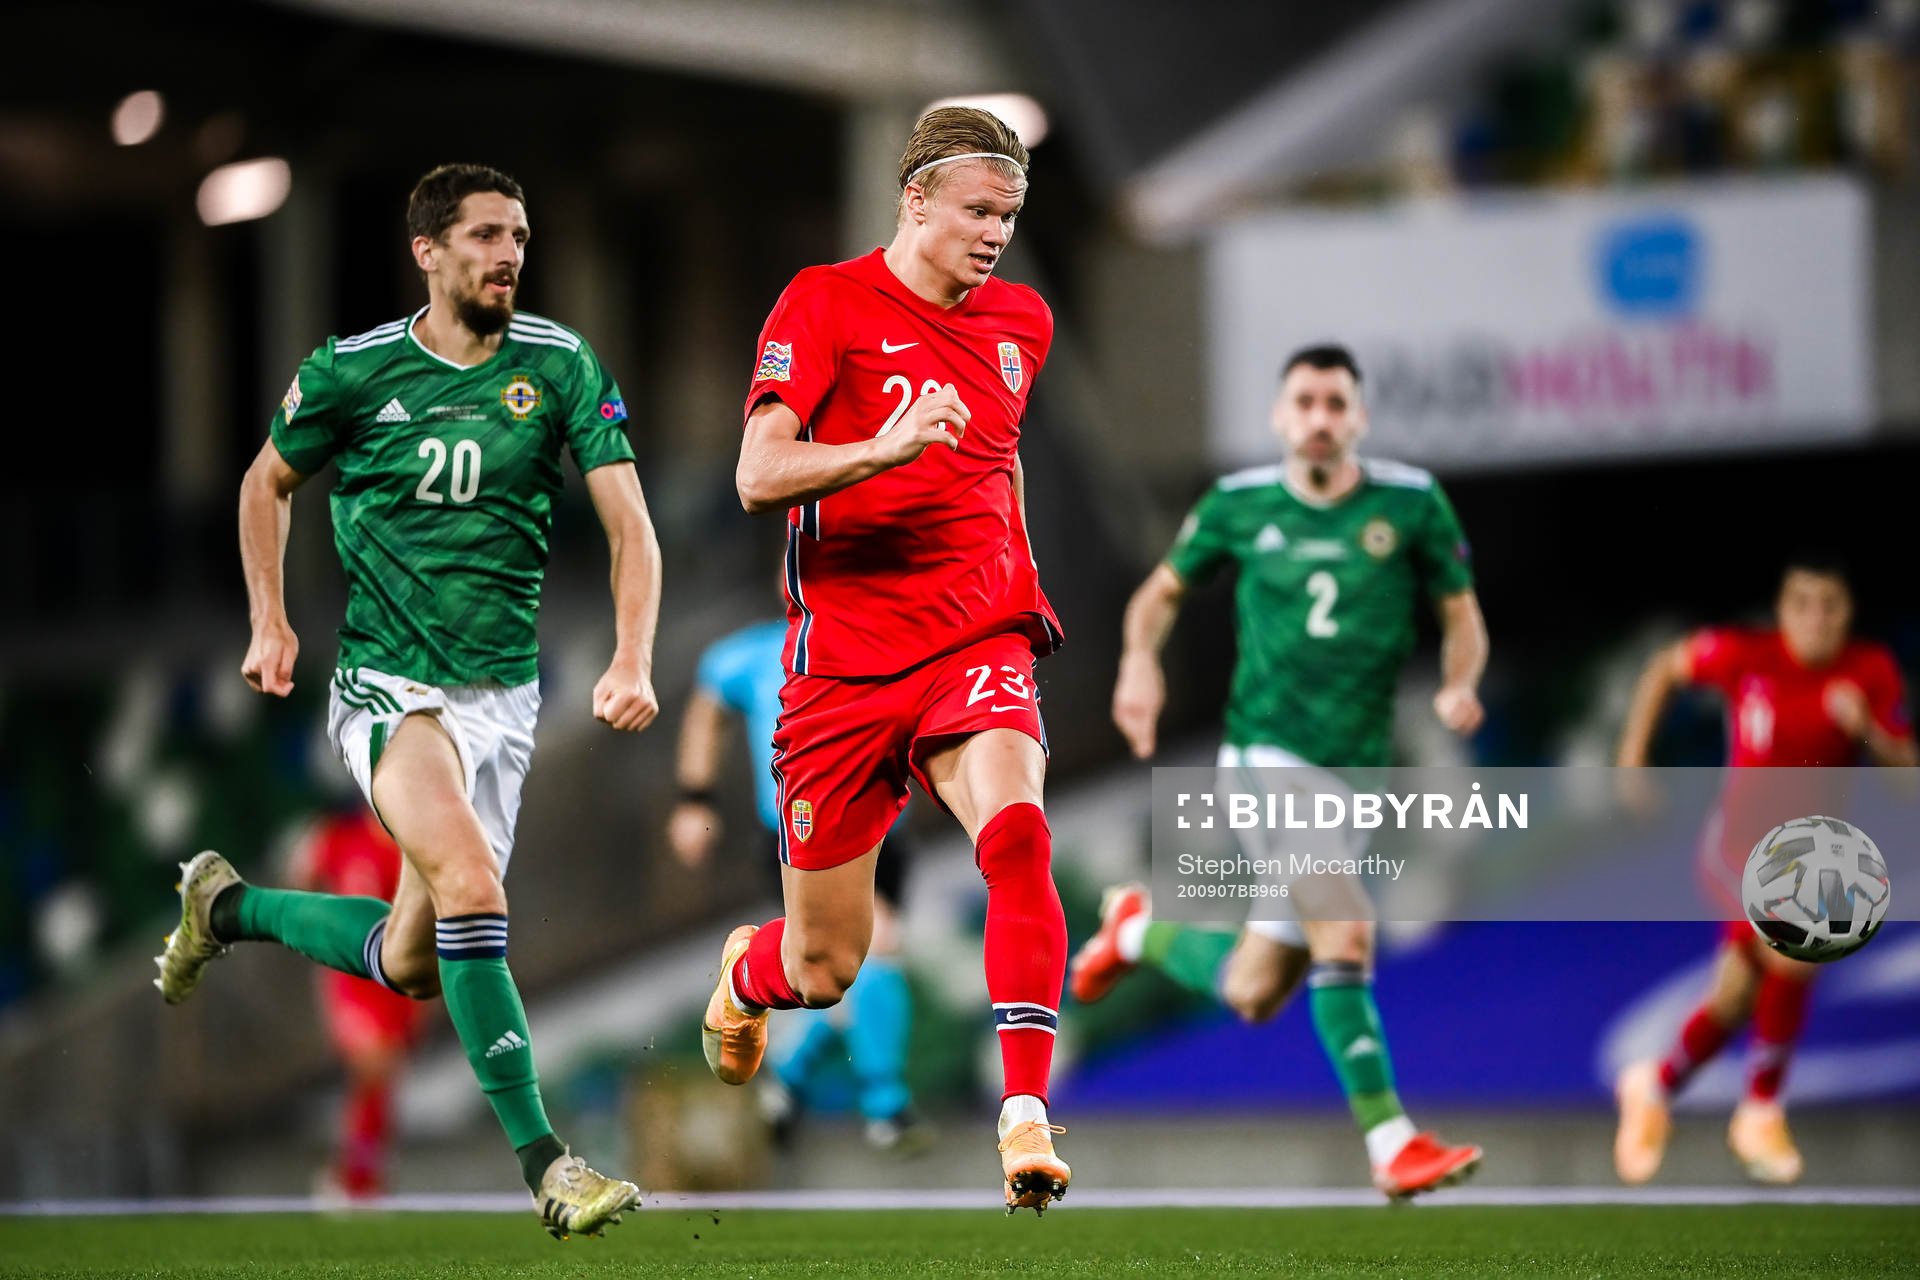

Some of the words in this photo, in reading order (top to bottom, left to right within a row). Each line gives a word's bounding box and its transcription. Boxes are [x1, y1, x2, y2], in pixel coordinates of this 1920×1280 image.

[415, 437, 482, 504] 20
[1305, 571, 1339, 638] 2
[965, 664, 1029, 708] 23
